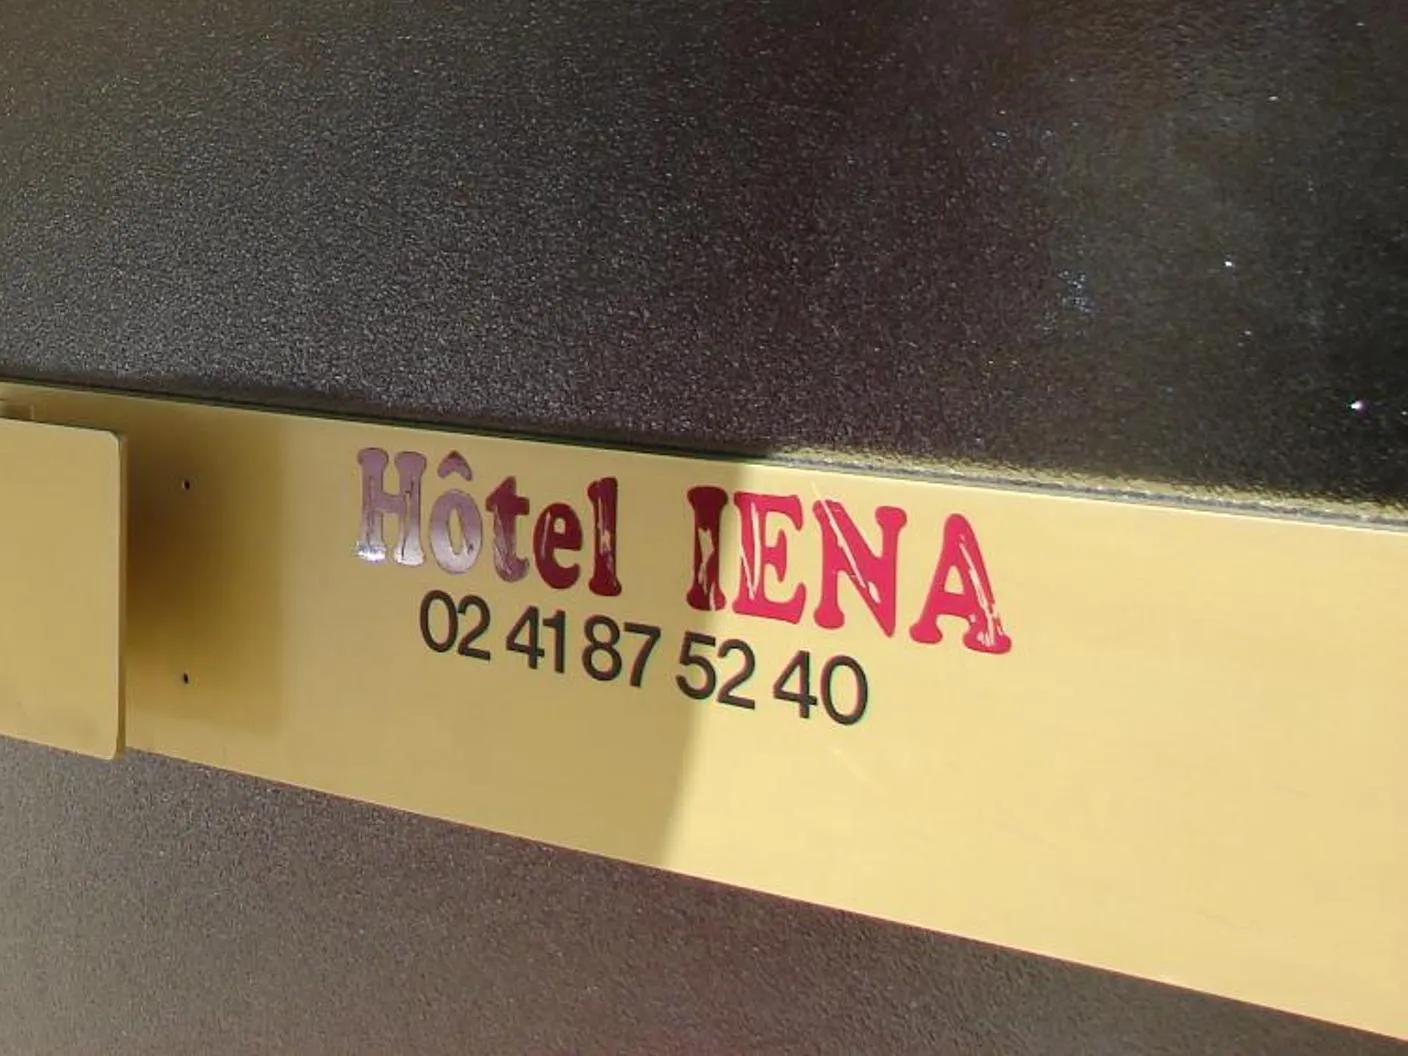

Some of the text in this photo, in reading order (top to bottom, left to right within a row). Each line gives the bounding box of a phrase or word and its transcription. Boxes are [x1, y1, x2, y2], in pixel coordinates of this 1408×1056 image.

[355, 447, 1012, 654] Hôtel IENA
[419, 589, 868, 725] 02 41 87 52 40
